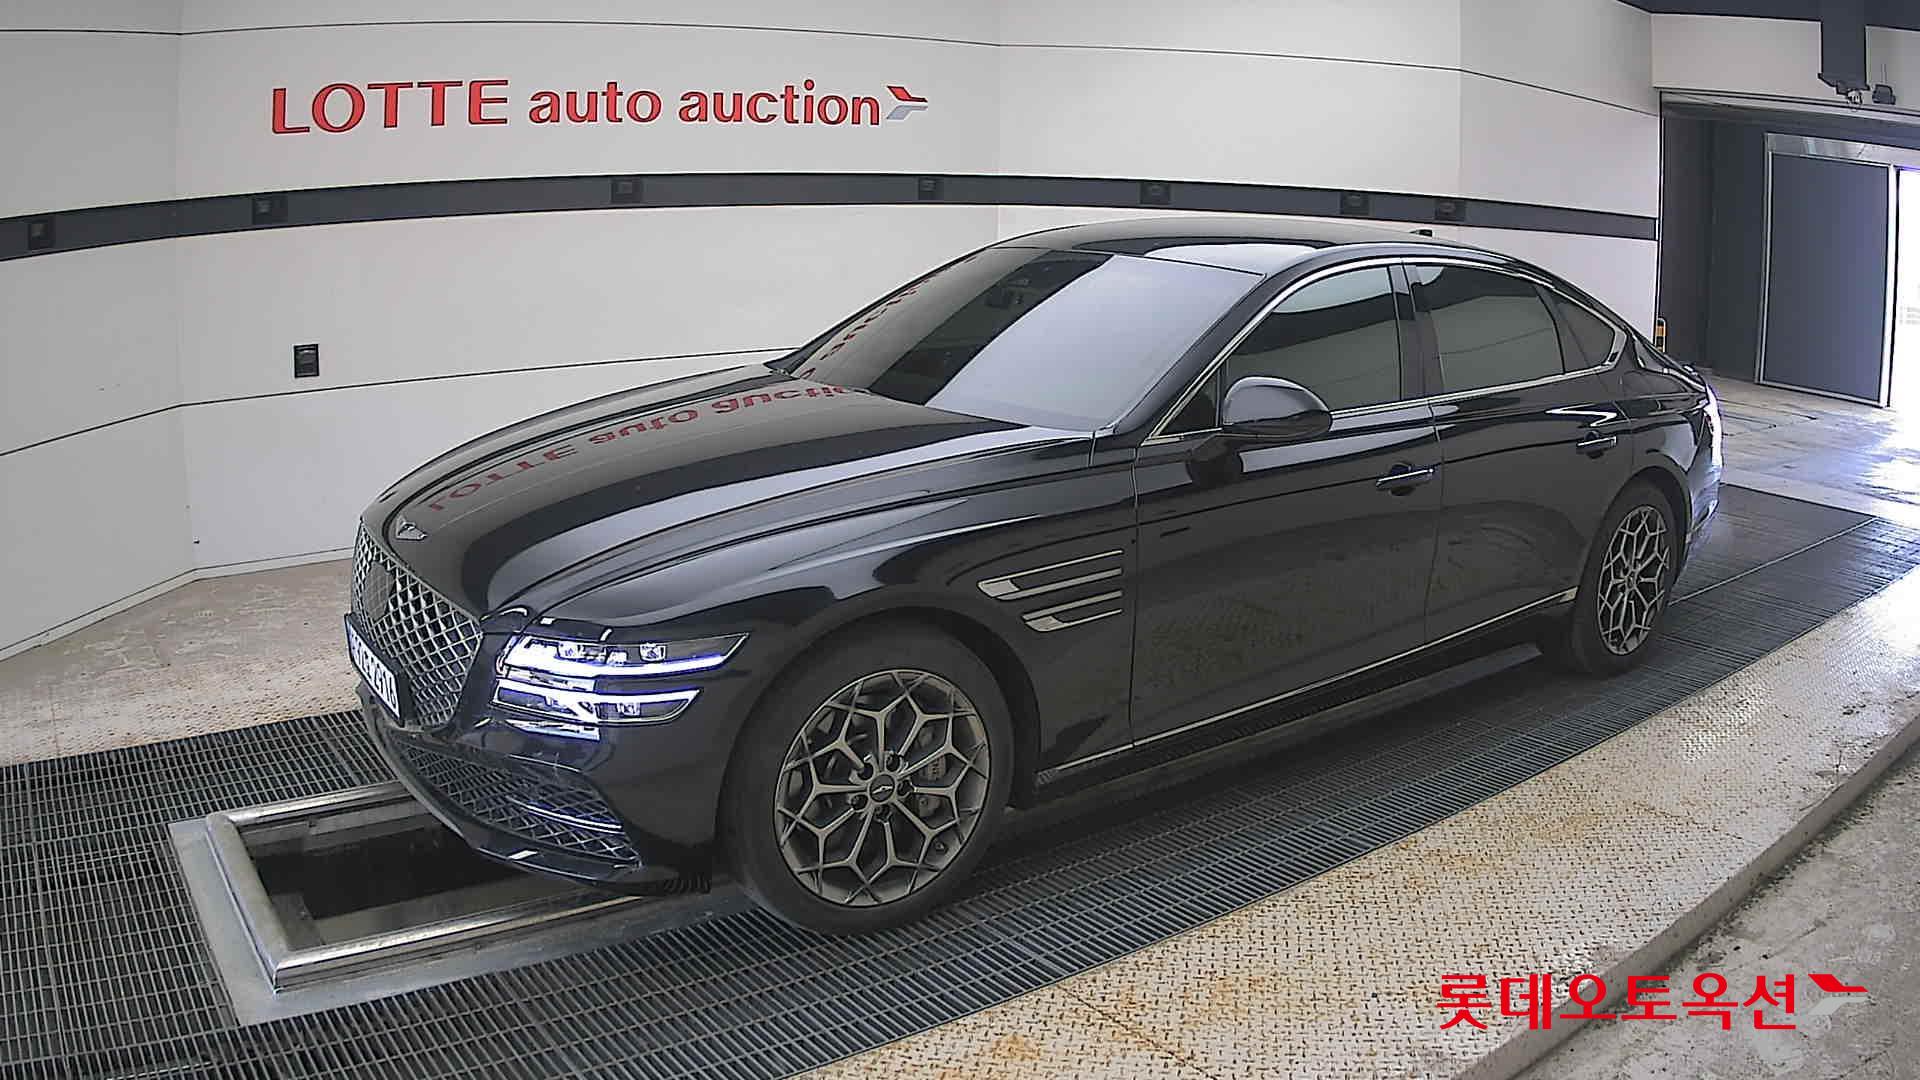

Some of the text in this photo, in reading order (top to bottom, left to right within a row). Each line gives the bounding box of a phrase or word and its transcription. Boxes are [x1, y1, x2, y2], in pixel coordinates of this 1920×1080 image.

[271, 79, 880, 135] LOTTE auto auction
